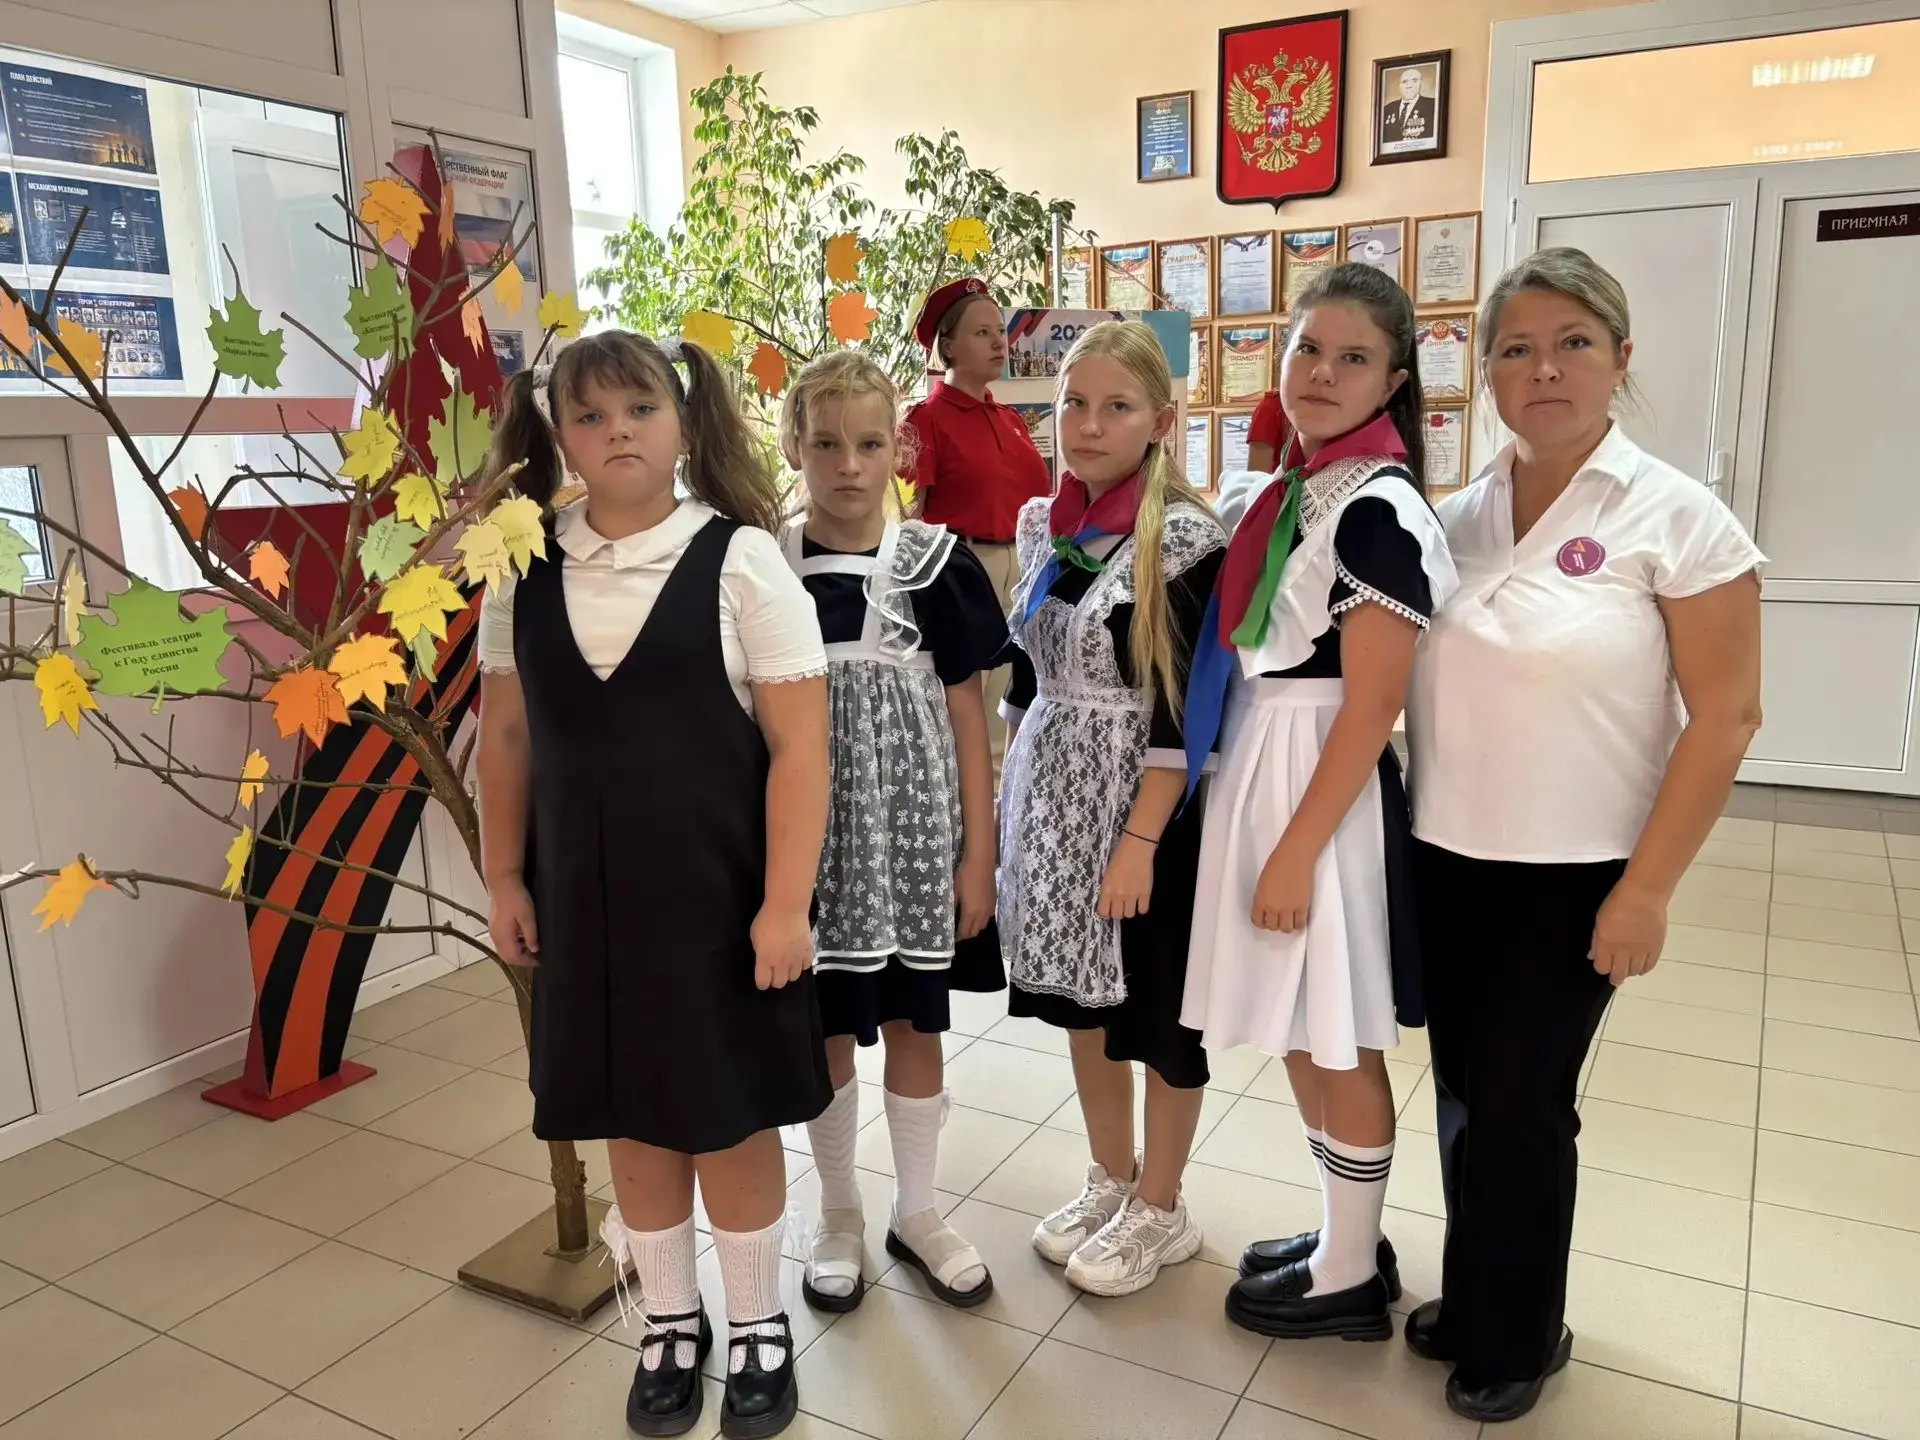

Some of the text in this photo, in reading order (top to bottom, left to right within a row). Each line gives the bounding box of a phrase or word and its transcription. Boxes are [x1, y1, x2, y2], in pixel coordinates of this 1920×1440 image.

[490, 170, 509, 180] ФЛАГ
[1831, 214, 1908, 230] ПРИЕМНАЯ
[1288, 260, 1329, 268] ГРАМОТА
[100, 631, 202, 656] Фестиваль театров
[114, 646, 199, 668] к Году единства
[141, 664, 180, 676] России
